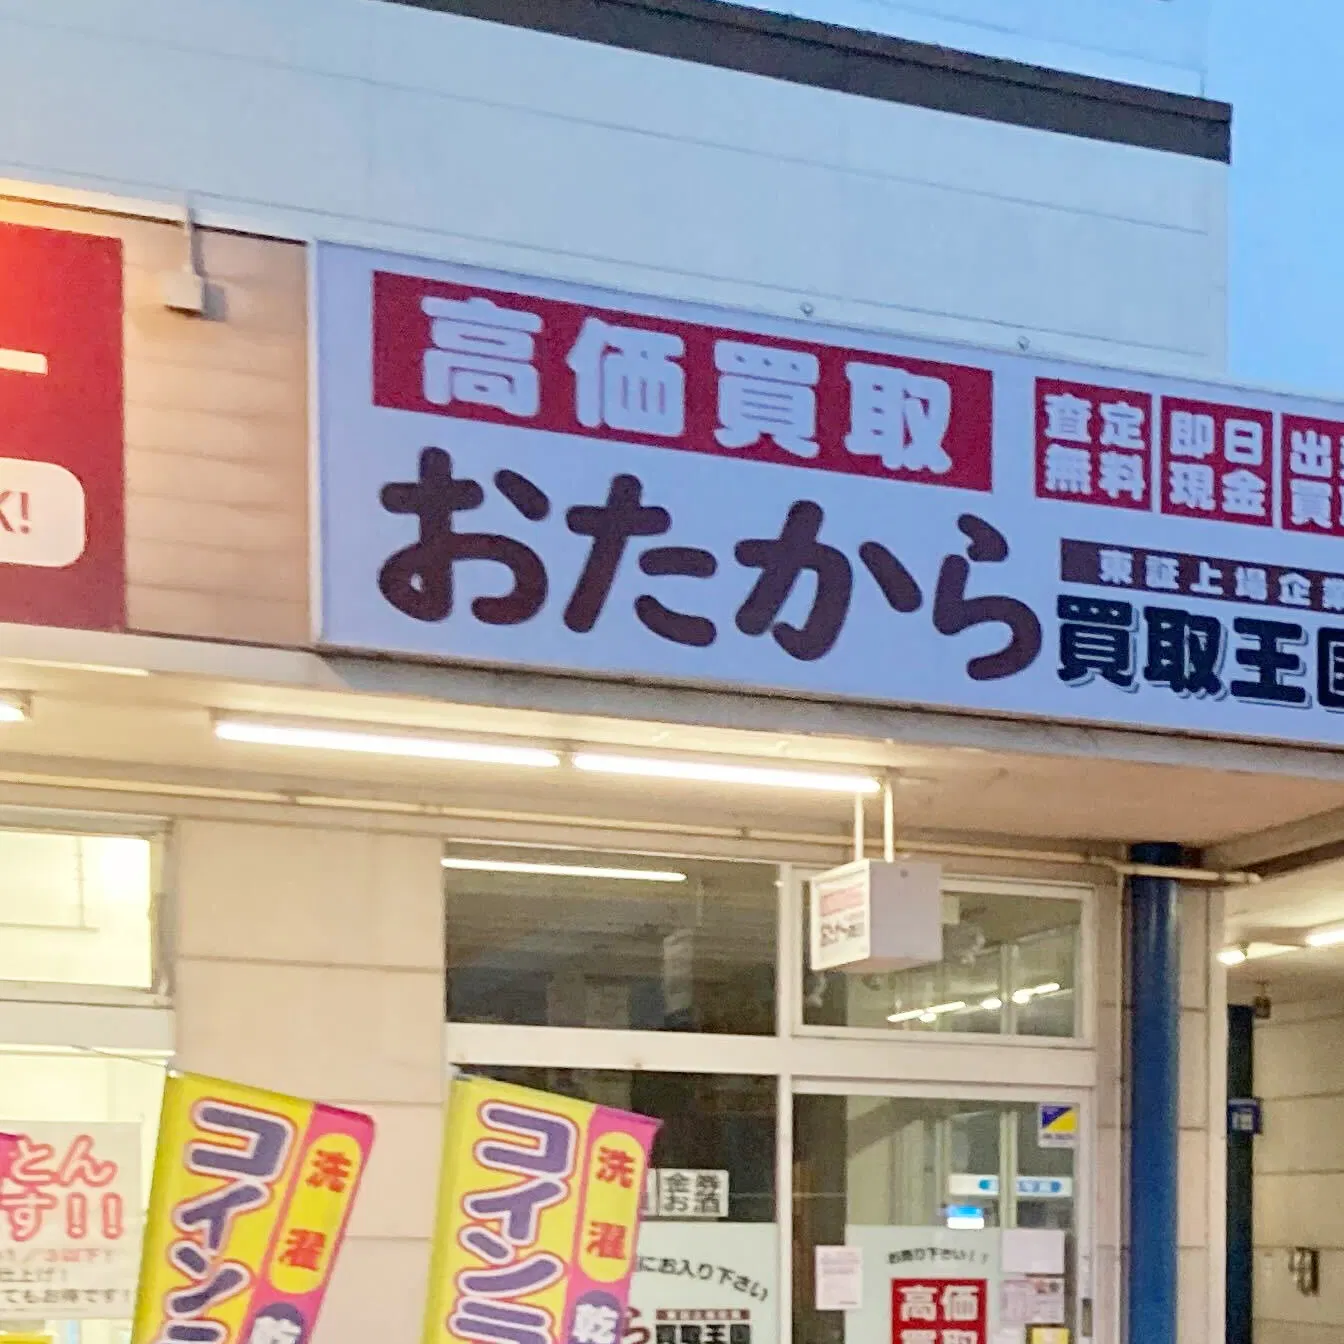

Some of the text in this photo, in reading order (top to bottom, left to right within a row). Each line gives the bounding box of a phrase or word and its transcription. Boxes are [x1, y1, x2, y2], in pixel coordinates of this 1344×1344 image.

[421, 294, 952, 475] 高価買取
[1044, 392, 1145, 450] 査定
[1170, 411, 1264, 466] 即日
[1044, 444, 1146, 500] 無料
[1169, 461, 1266, 517] 現金
[378, 446, 1042, 682] おたから
[277, 1148, 353, 1273] 洗濯
[585, 1146, 636, 1261] 洗濯
[899, 1285, 979, 1322] 高価
